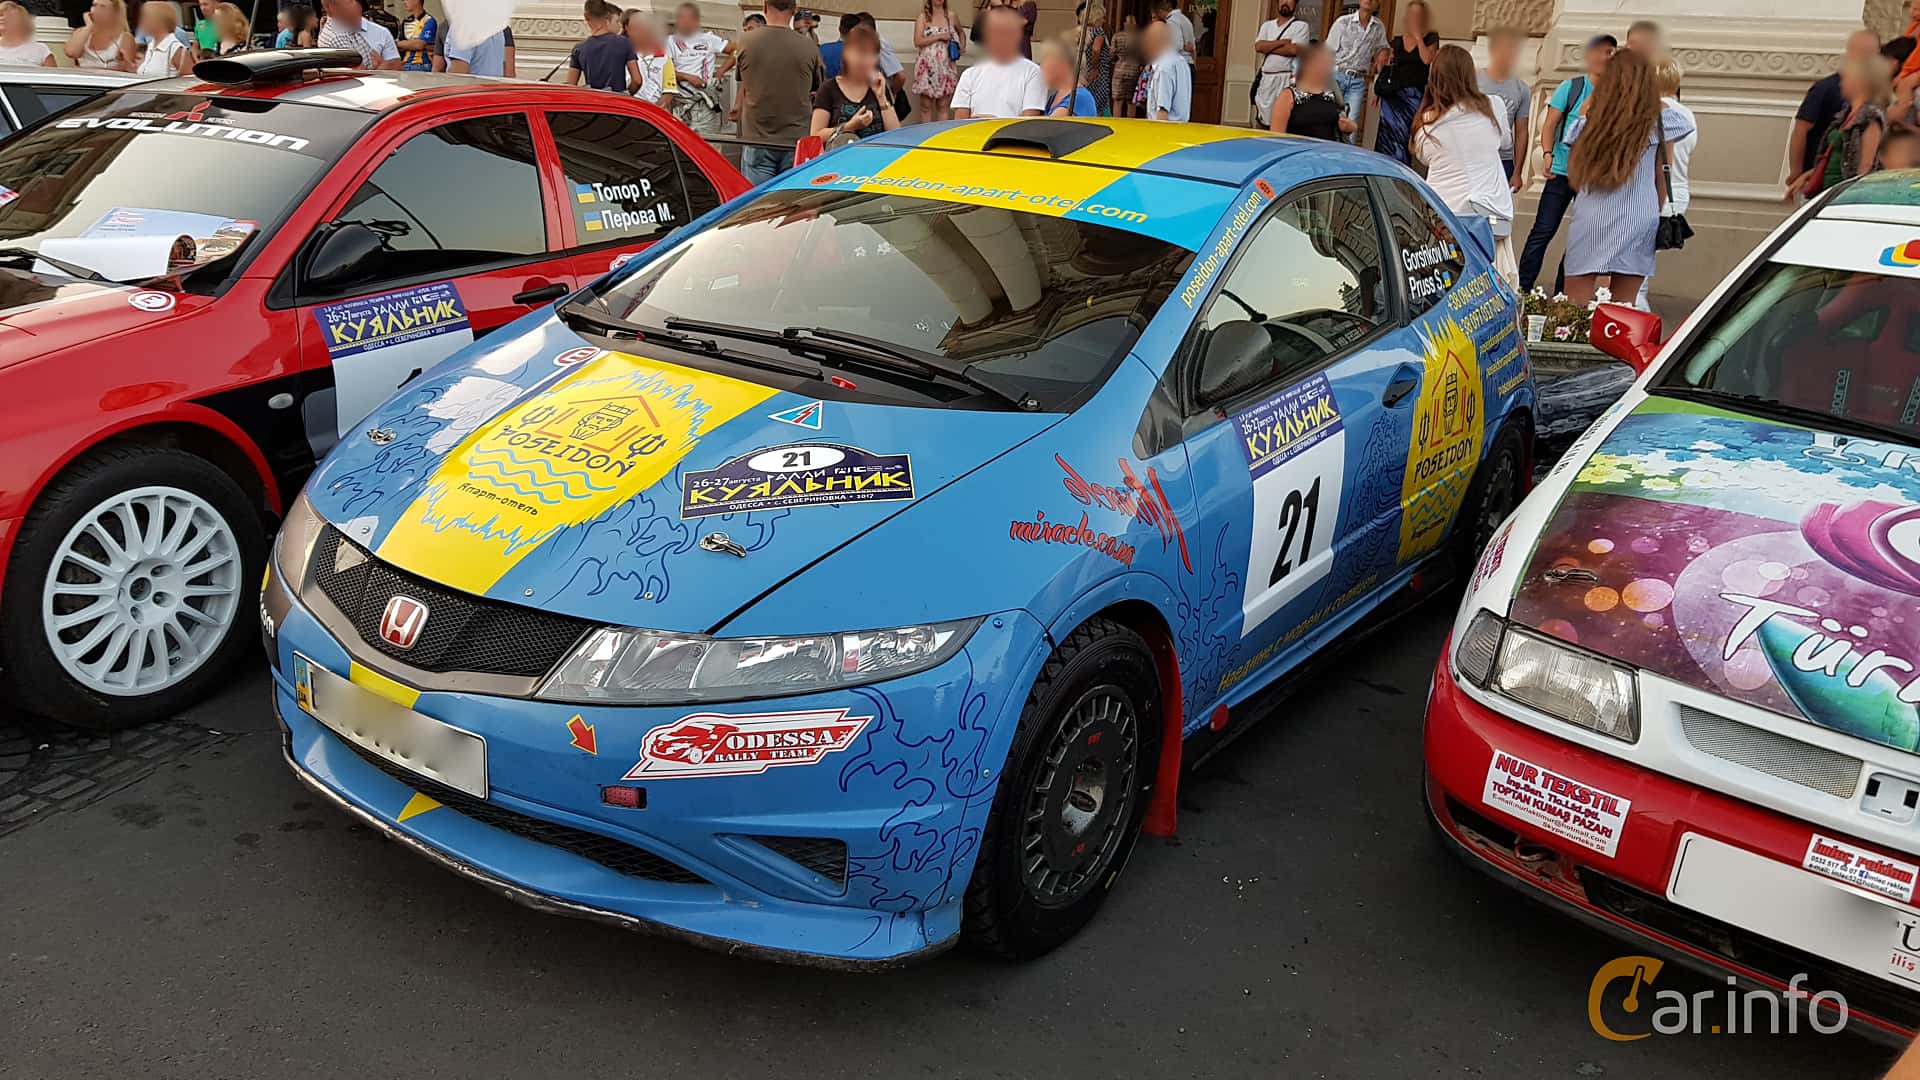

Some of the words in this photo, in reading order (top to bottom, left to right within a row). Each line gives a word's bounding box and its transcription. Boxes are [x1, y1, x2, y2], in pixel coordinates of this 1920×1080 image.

[56, 118, 310, 150] EVOLUTION
[593, 182, 640, 203] Топор
[640, 179, 655, 197] Р.
[834, 174, 1148, 224] poseidon-apart-otel.com
[601, 208, 657, 232] Перова
[656, 202, 675, 221] М.
[1180, 191, 1262, 309] poseidon-apart-otel.com
[1402, 243, 1442, 272] Gorshkov
[1408, 274, 1436, 300] Pruss
[1434, 268, 1446, 290] S.
[330, 298, 462, 344] КУЯЛЬНИК
[373, 299, 410, 316] РАЛЛИ
[1246, 394, 1337, 460] КУЯЛЬНИК
[492, 424, 636, 478] POSEIDON
[782, 451, 811, 467] 21
[1413, 435, 1473, 484] POSEIDON
[690, 471, 910, 504] КУЯЛЬНИК
[693, 477, 729, 488] 26-27
[767, 469, 826, 483] РАЛЛИ
[729, 501, 765, 511] ОДЕССА
[782, 494, 847, 505] СЕВЕРИНОВКА
[1268, 475, 1321, 588] 21
[1718, 592, 1920, 703] Tür
[726, 730, 835, 750] ODESSA
[715, 752, 759, 762] RALLY
[1495, 753, 1538, 784] NUR
[1492, 781, 1531, 806] TOPTAN
[1533, 799, 1571, 823] KUMAŞ
[1572, 814, 1614, 839] PAZARI
